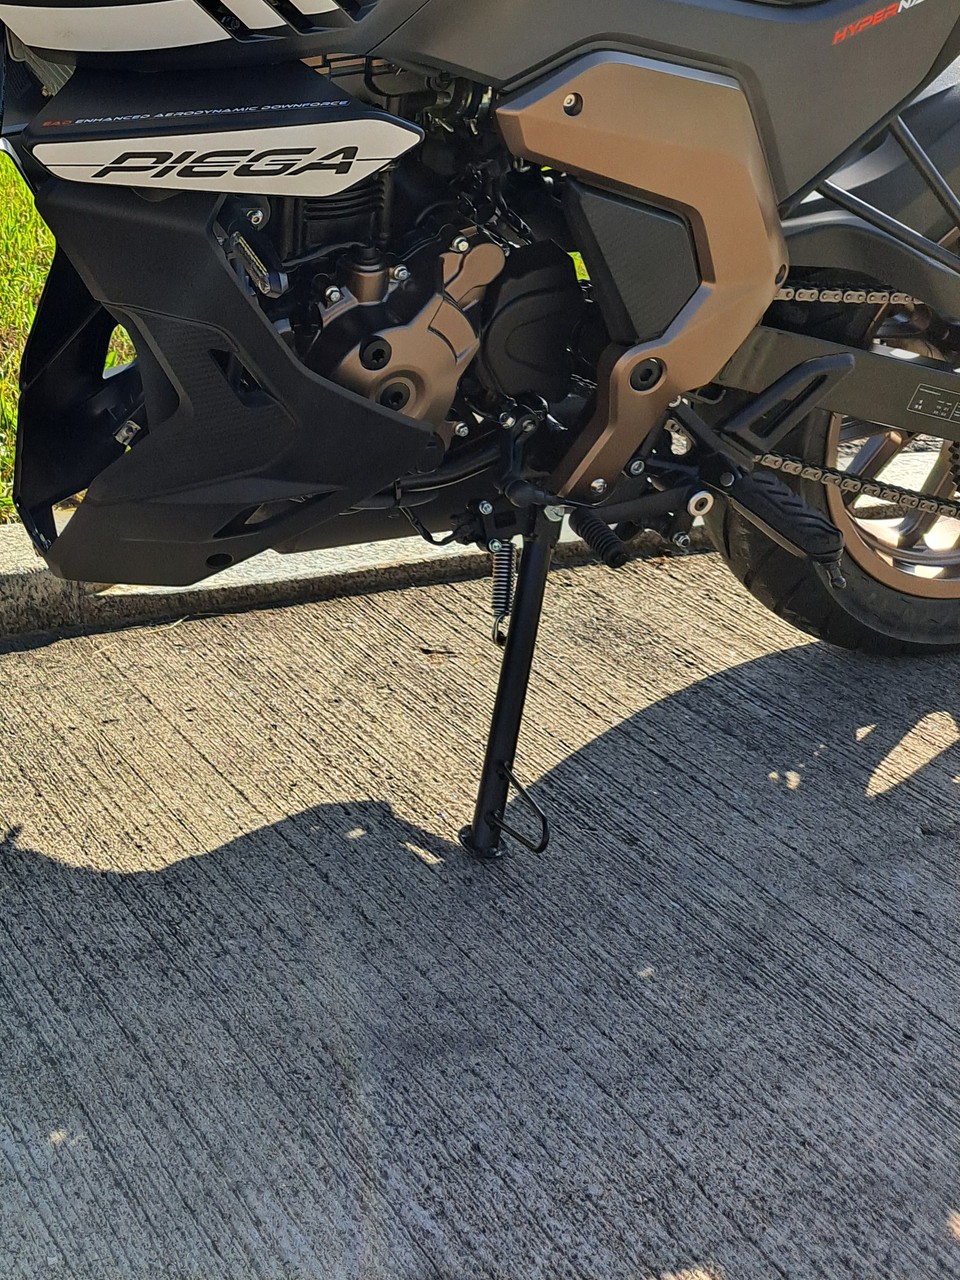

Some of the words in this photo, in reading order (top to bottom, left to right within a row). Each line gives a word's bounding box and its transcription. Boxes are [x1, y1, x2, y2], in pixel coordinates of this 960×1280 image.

[75, 114, 150, 124] ENHANCED
[154, 106, 259, 118] AERODYNAMIC
[261, 100, 350, 111] DOWNFORCE
[91, 146, 359, 178] PIEGA
